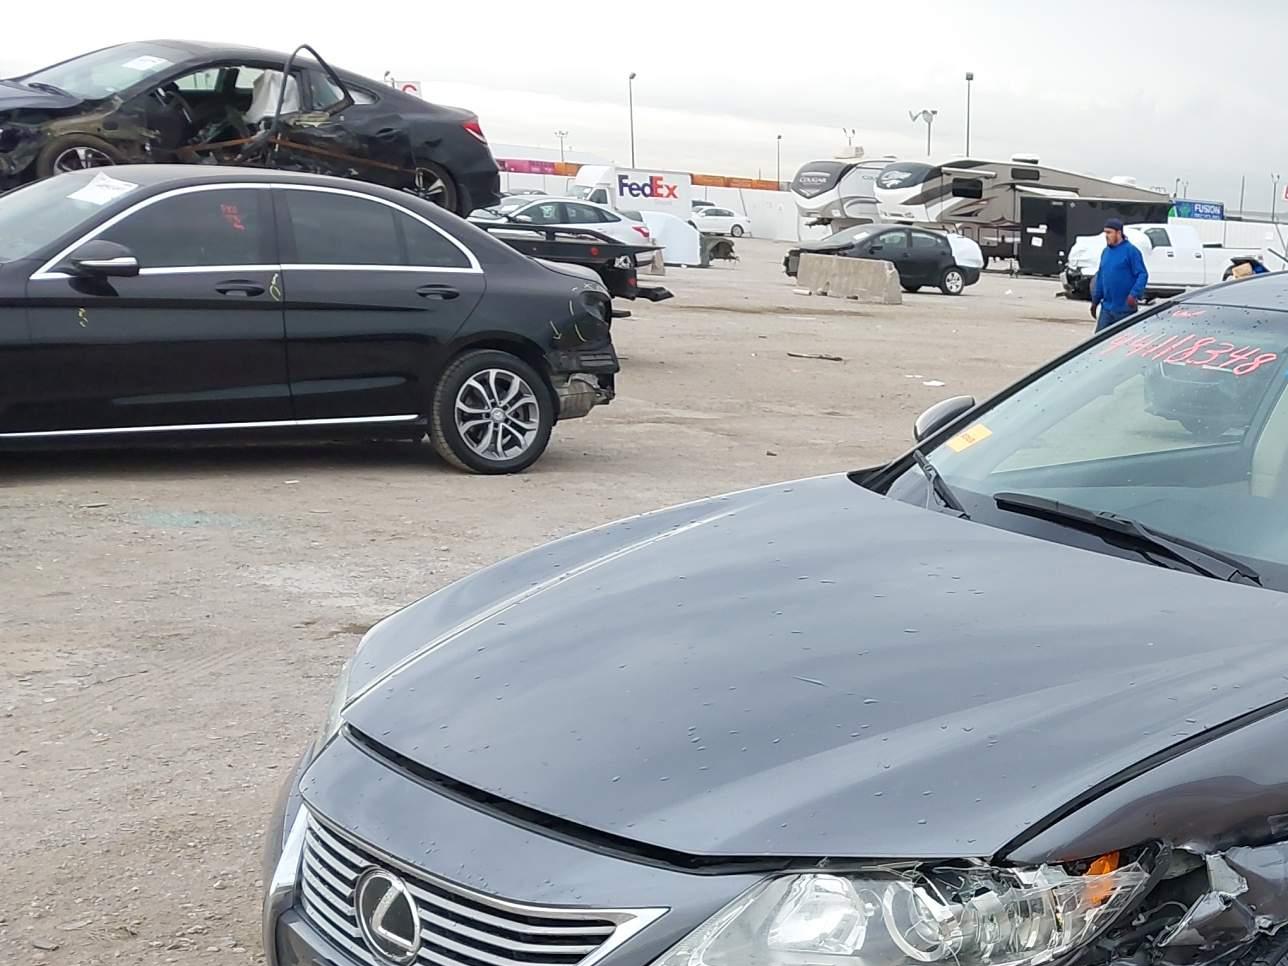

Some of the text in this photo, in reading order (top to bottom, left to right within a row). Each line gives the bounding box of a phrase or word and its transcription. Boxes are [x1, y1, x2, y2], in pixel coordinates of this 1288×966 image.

[617, 174, 679, 199] FedEx
[1194, 203, 1221, 215] FUSION
[1099, 333, 1277, 376] 44118348
